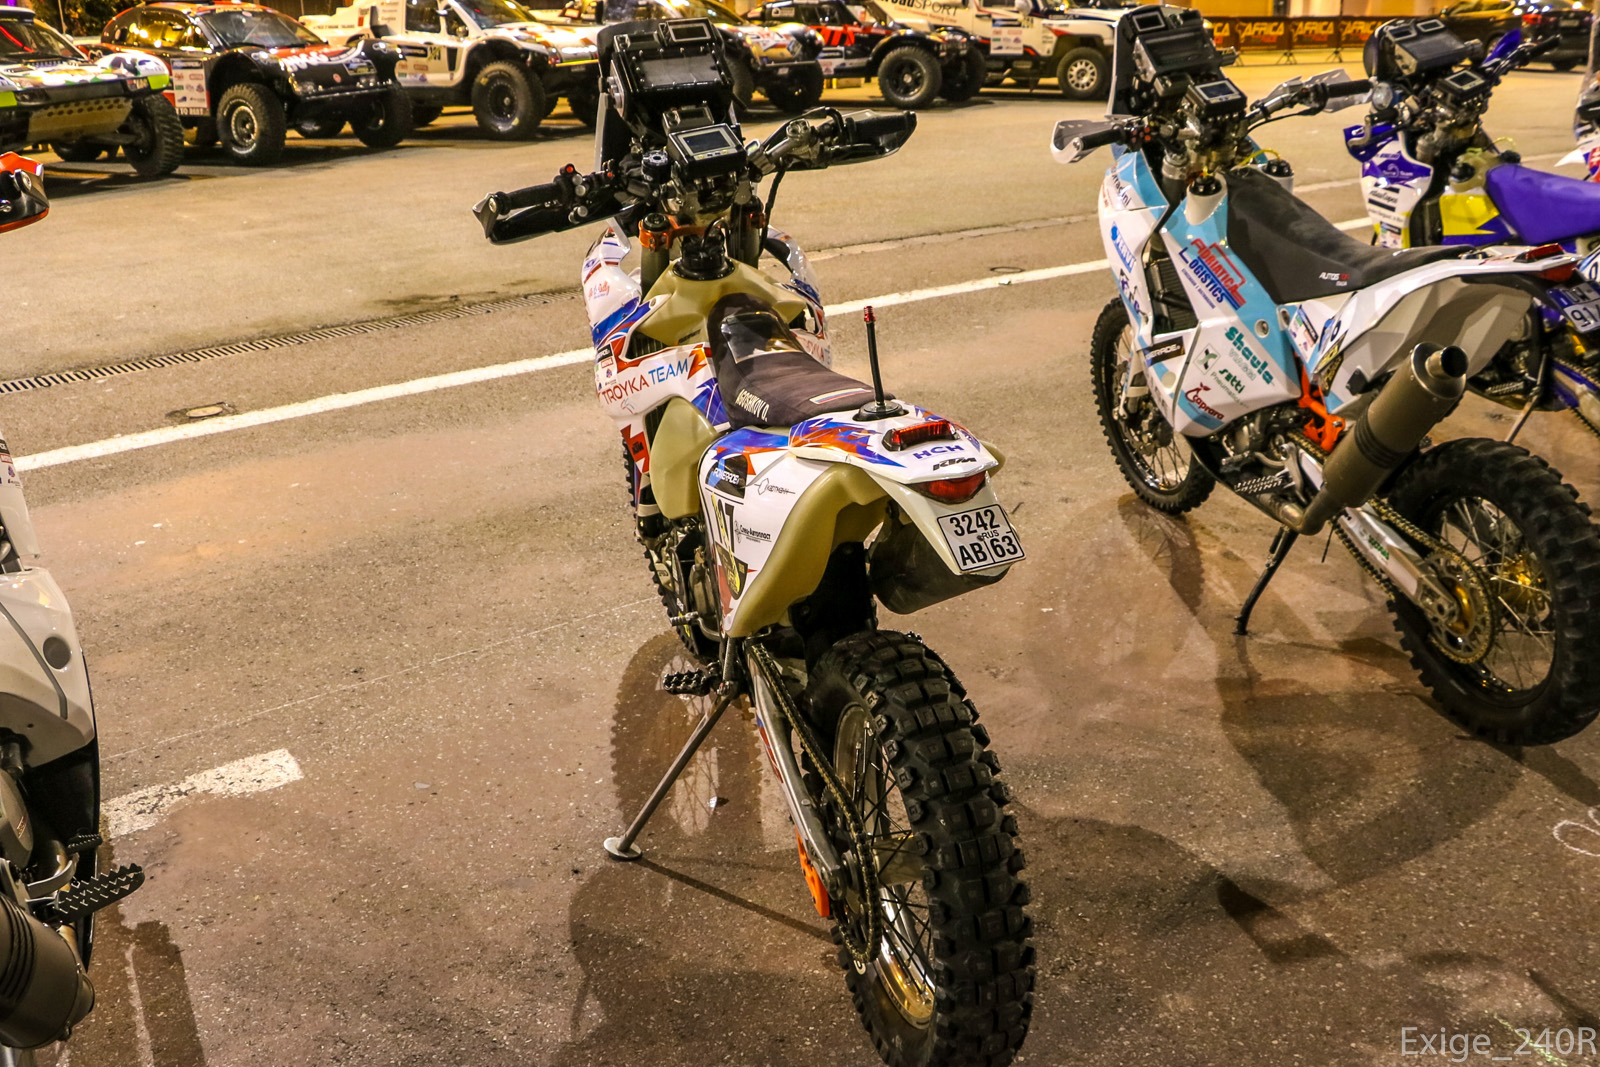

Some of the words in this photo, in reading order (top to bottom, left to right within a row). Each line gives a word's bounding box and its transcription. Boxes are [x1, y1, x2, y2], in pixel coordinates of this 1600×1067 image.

[1179, 247, 1225, 303] LOGISTICS
[1190, 238, 1240, 293] ADRIATICA
[601, 374, 650, 405] TROYKA
[648, 358, 689, 385] TEAM
[932, 457, 977, 471] KTM
[949, 509, 1000, 536] 3242
[982, 529, 1000, 539] RUS
[989, 535, 1018, 558] 63
